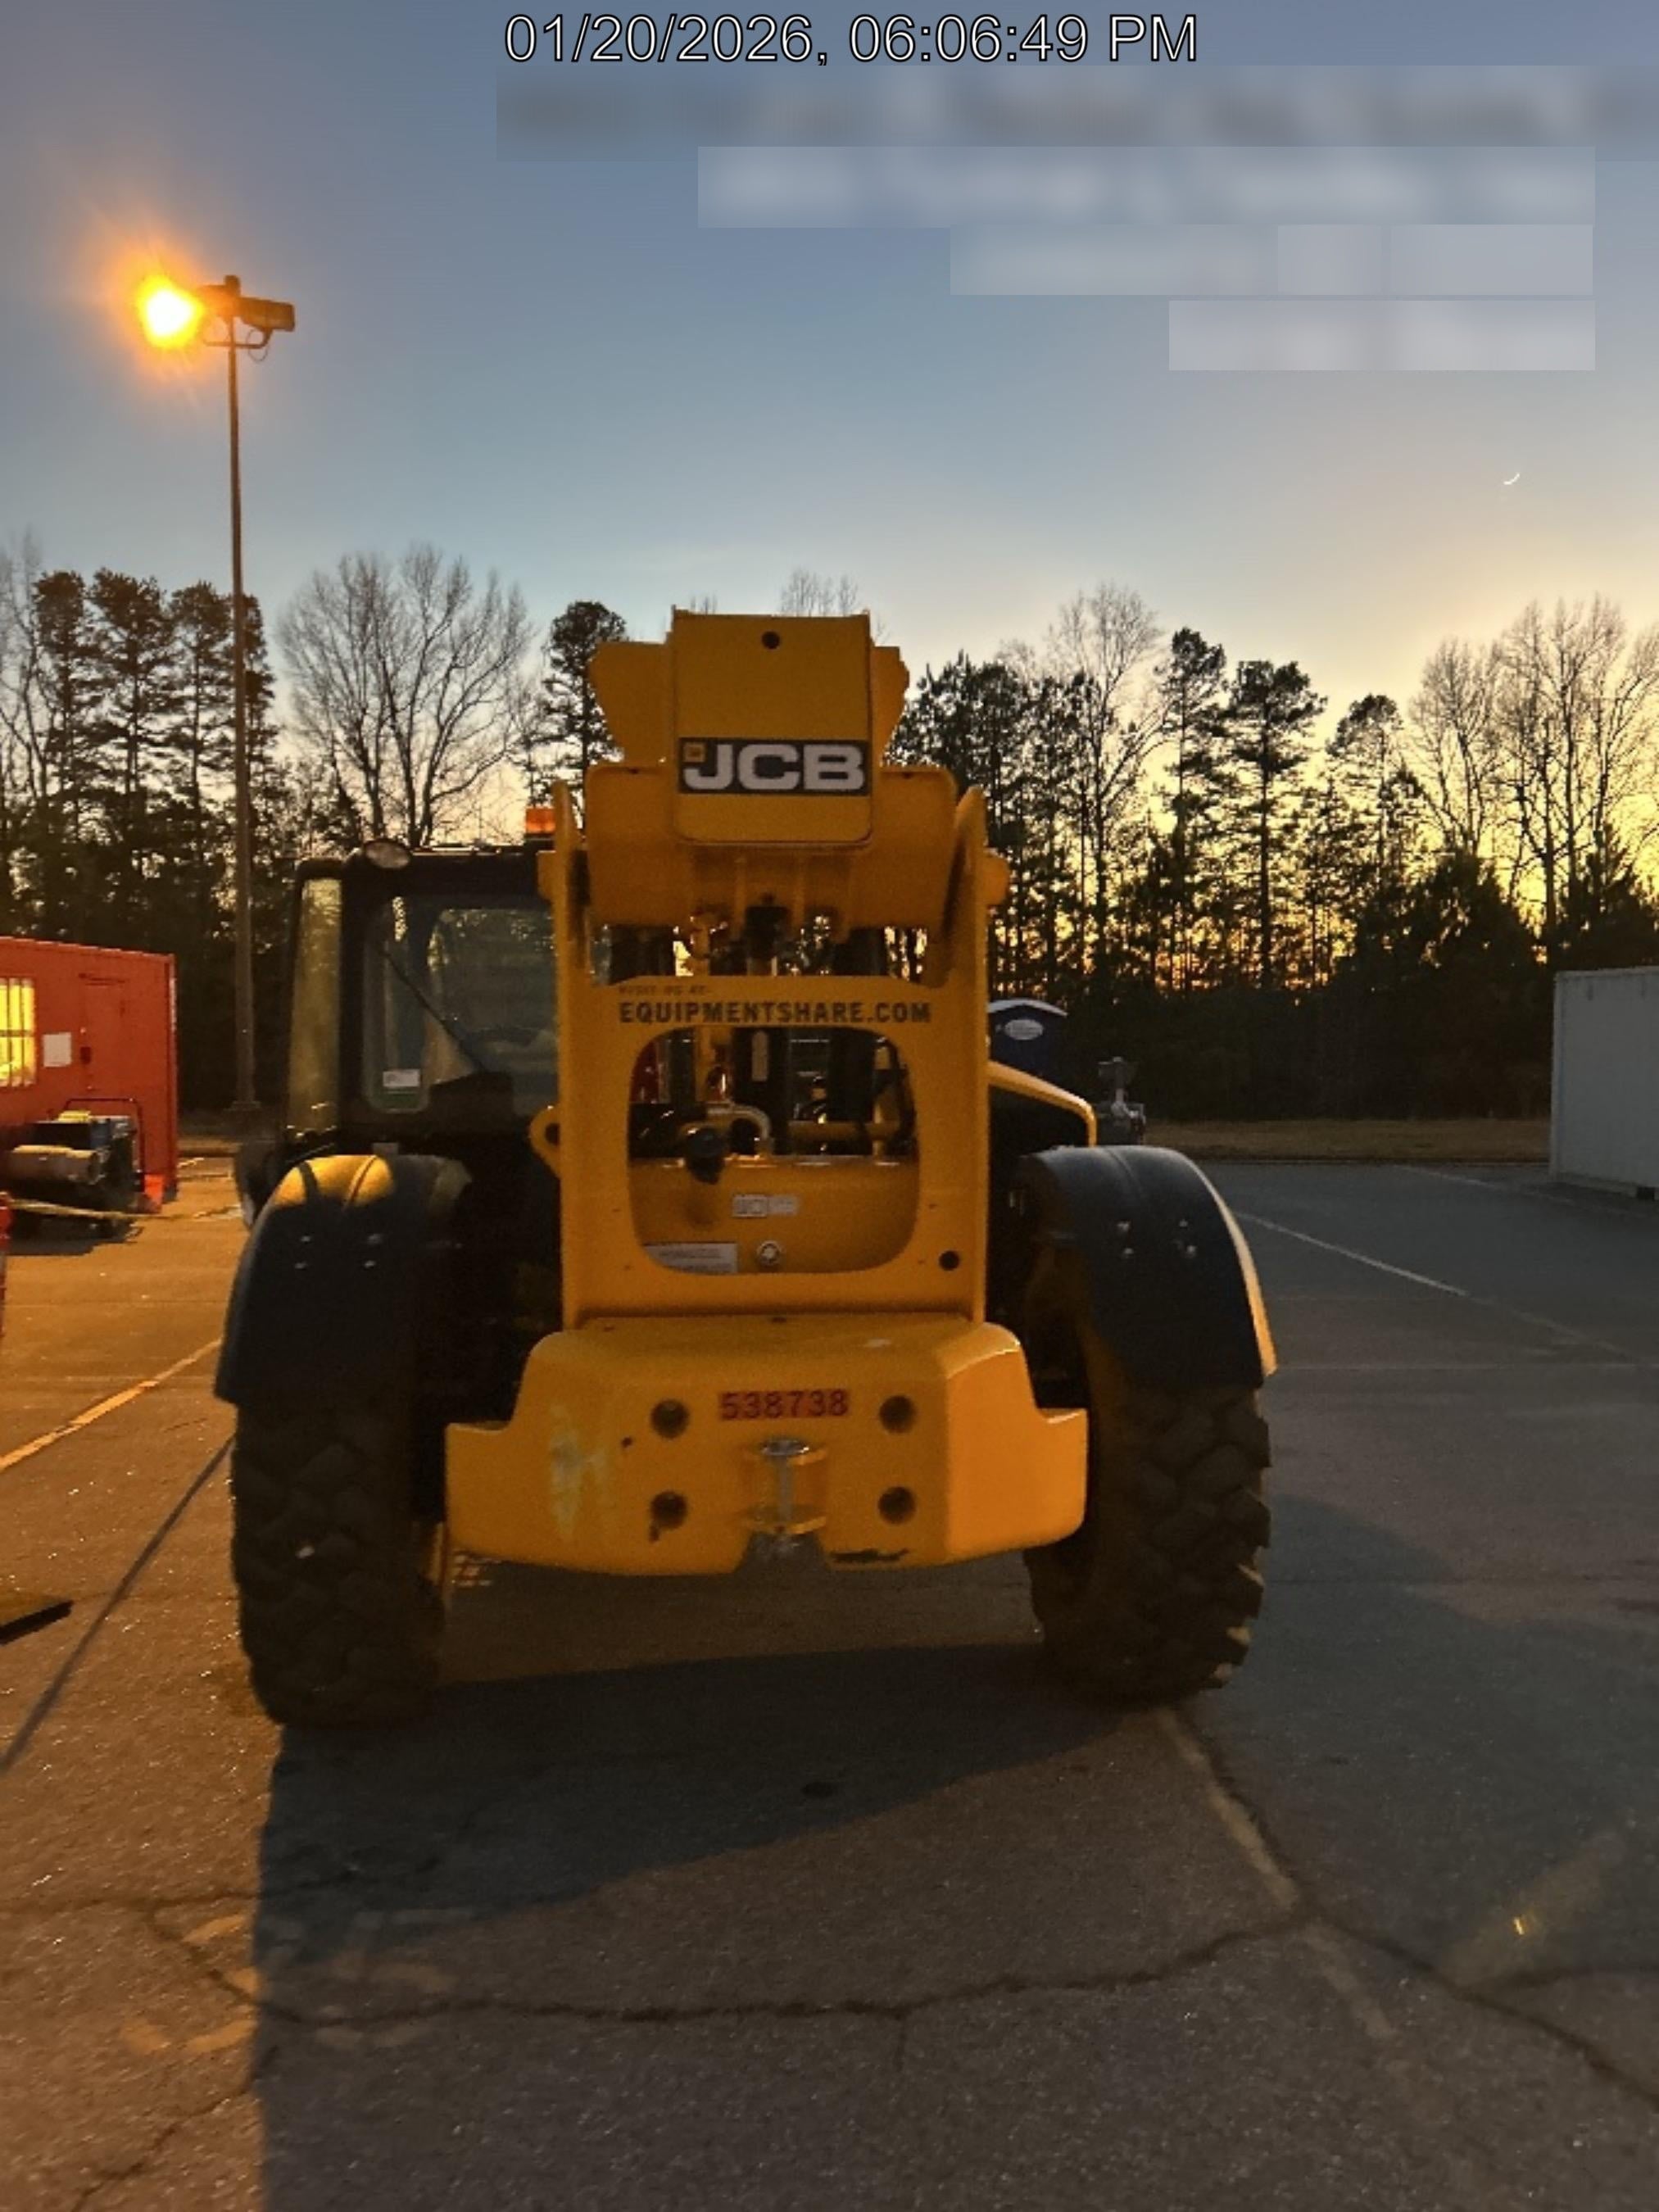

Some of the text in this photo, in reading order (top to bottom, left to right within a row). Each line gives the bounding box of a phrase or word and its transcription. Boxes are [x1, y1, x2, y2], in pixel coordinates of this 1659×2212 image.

[683, 743, 864, 791] JCB
[619, 1001, 931, 1024] EQUIPMENTSHARE.COM
[721, 1389, 848, 1420] 538738
